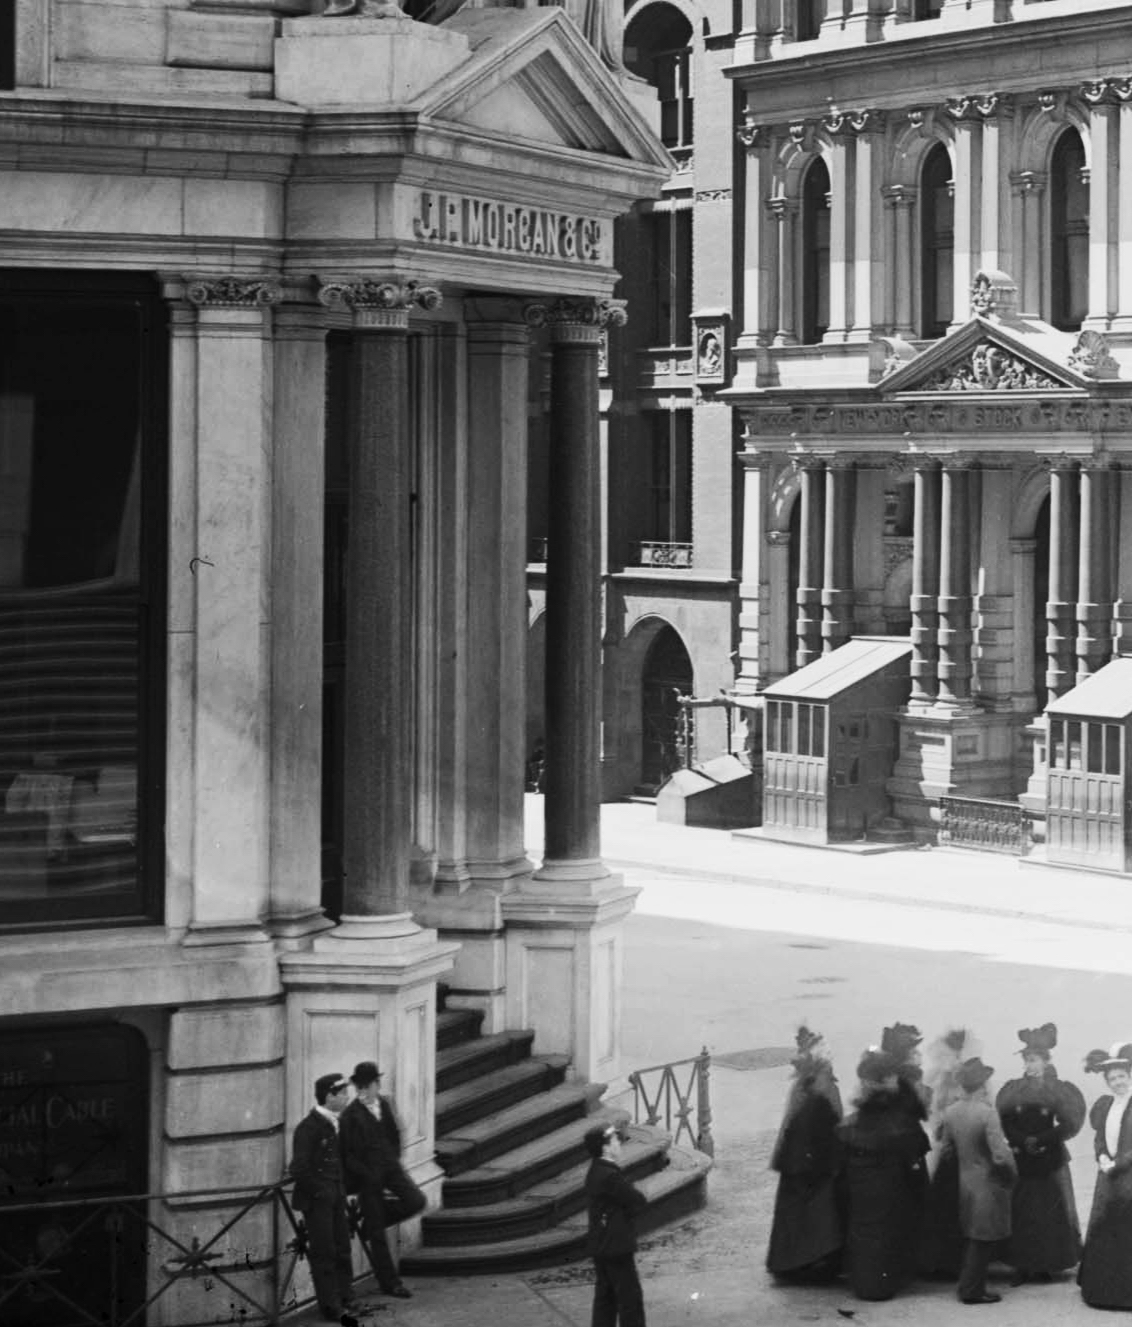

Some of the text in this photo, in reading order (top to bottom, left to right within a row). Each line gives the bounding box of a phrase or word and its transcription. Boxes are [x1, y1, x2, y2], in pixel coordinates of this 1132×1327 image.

[461, 197, 559, 255] MORGAN
[558, 214, 577, 259] &
[974, 407, 1023, 427] STOCK
